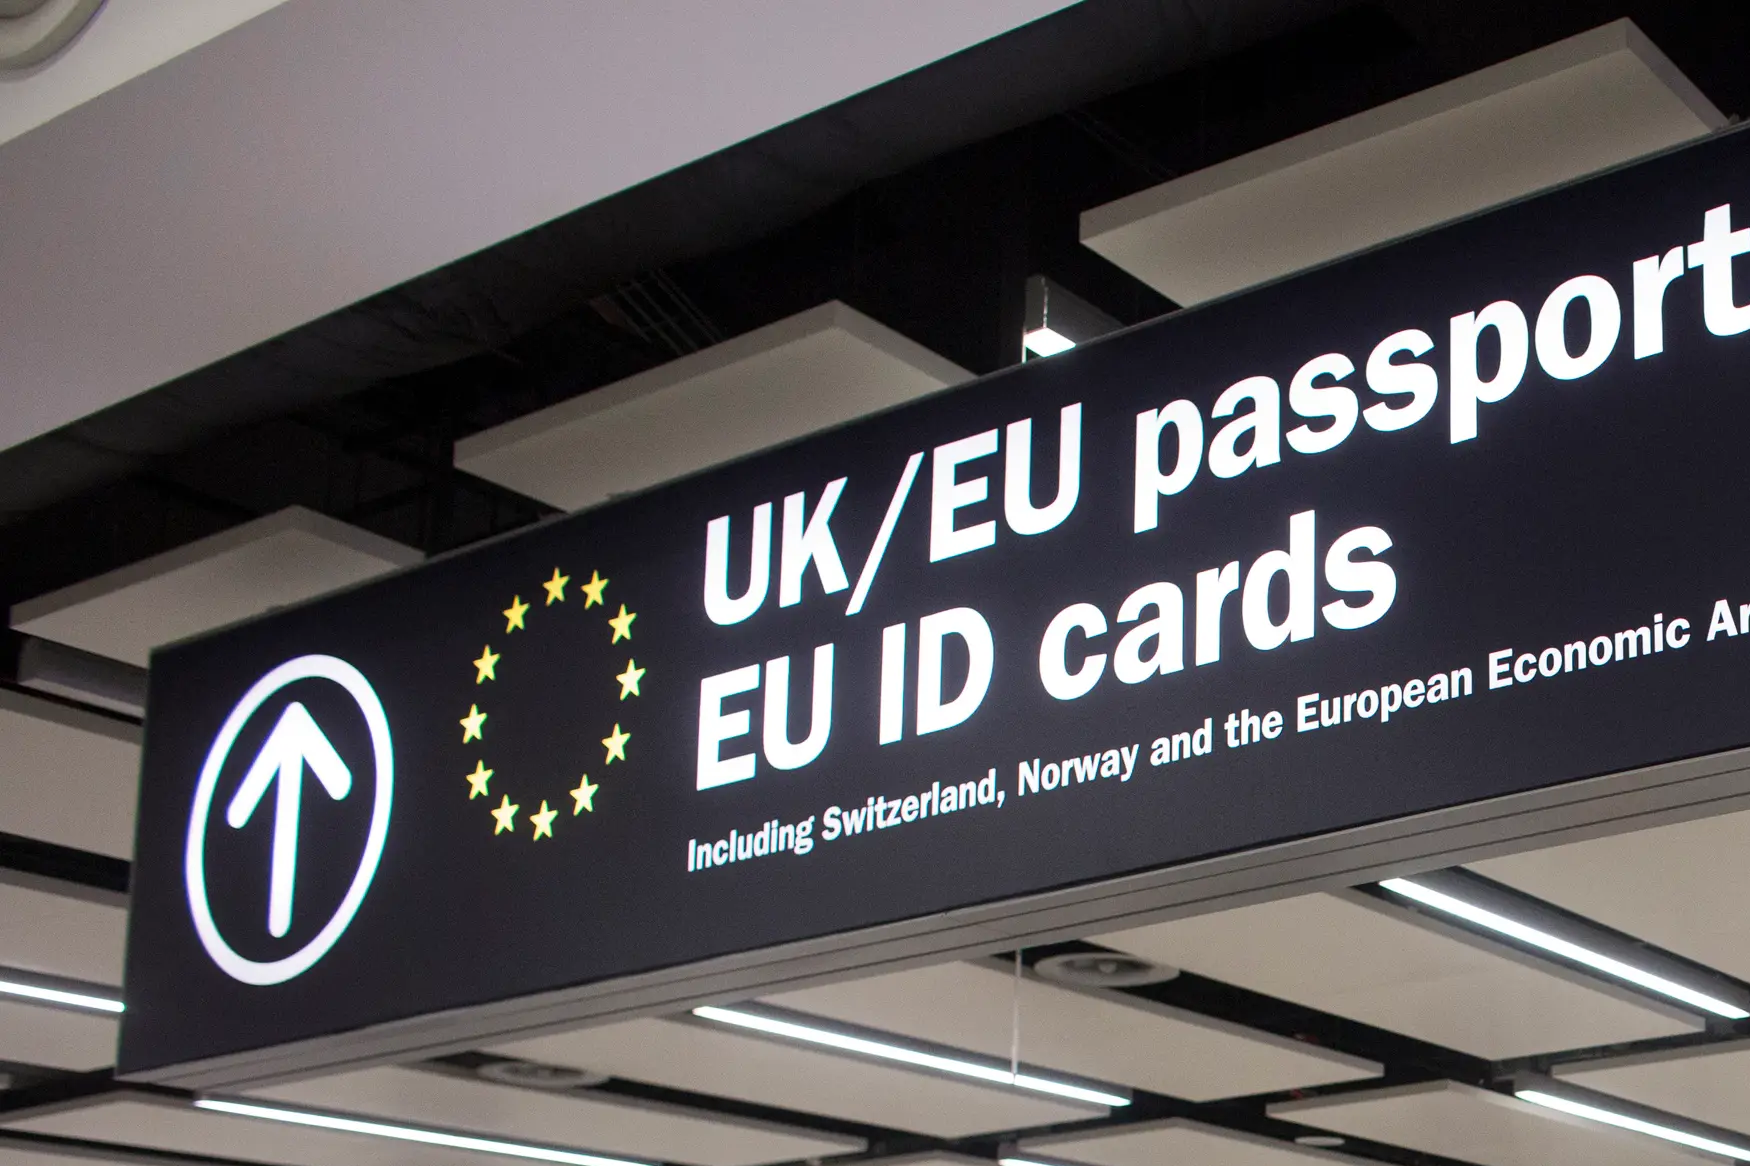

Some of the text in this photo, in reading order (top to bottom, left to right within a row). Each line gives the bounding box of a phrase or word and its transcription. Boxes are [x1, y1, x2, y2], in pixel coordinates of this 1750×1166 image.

[703, 402, 1082, 626] UK/EU
[687, 815, 815, 872] Including
[821, 767, 1006, 842] Switzerland,
[1017, 743, 1140, 797] Norway
[1149, 717, 1213, 767] and
[1223, 708, 1284, 748] the
[1296, 667, 1473, 733] European
[1488, 612, 1691, 690] Economic
[696, 509, 1397, 792] EU ID cards
